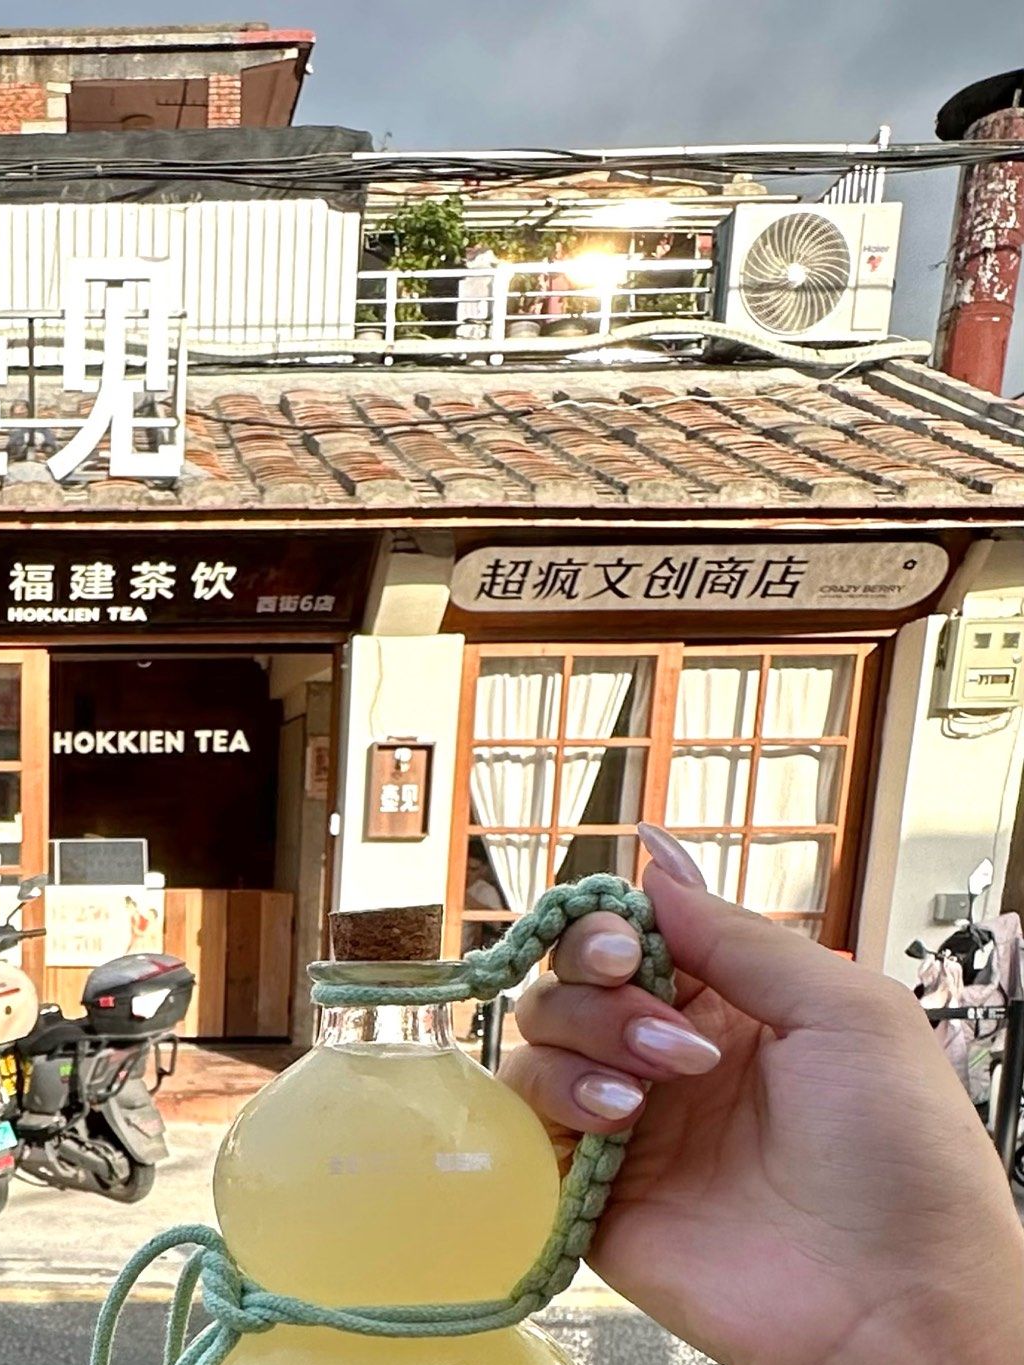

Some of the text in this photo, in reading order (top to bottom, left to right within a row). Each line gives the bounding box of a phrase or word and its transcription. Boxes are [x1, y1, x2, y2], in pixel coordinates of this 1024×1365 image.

[9, 562, 237, 601] 福建茶饮
[474, 556, 810, 600] 超疯文创商店
[819, 585, 906, 593] CRAZY BERRY
[7, 606, 148, 623] HOKKIEN TEA
[256, 595, 336, 613] 西街6店
[53, 729, 251, 754] HOKKIEN TEA
